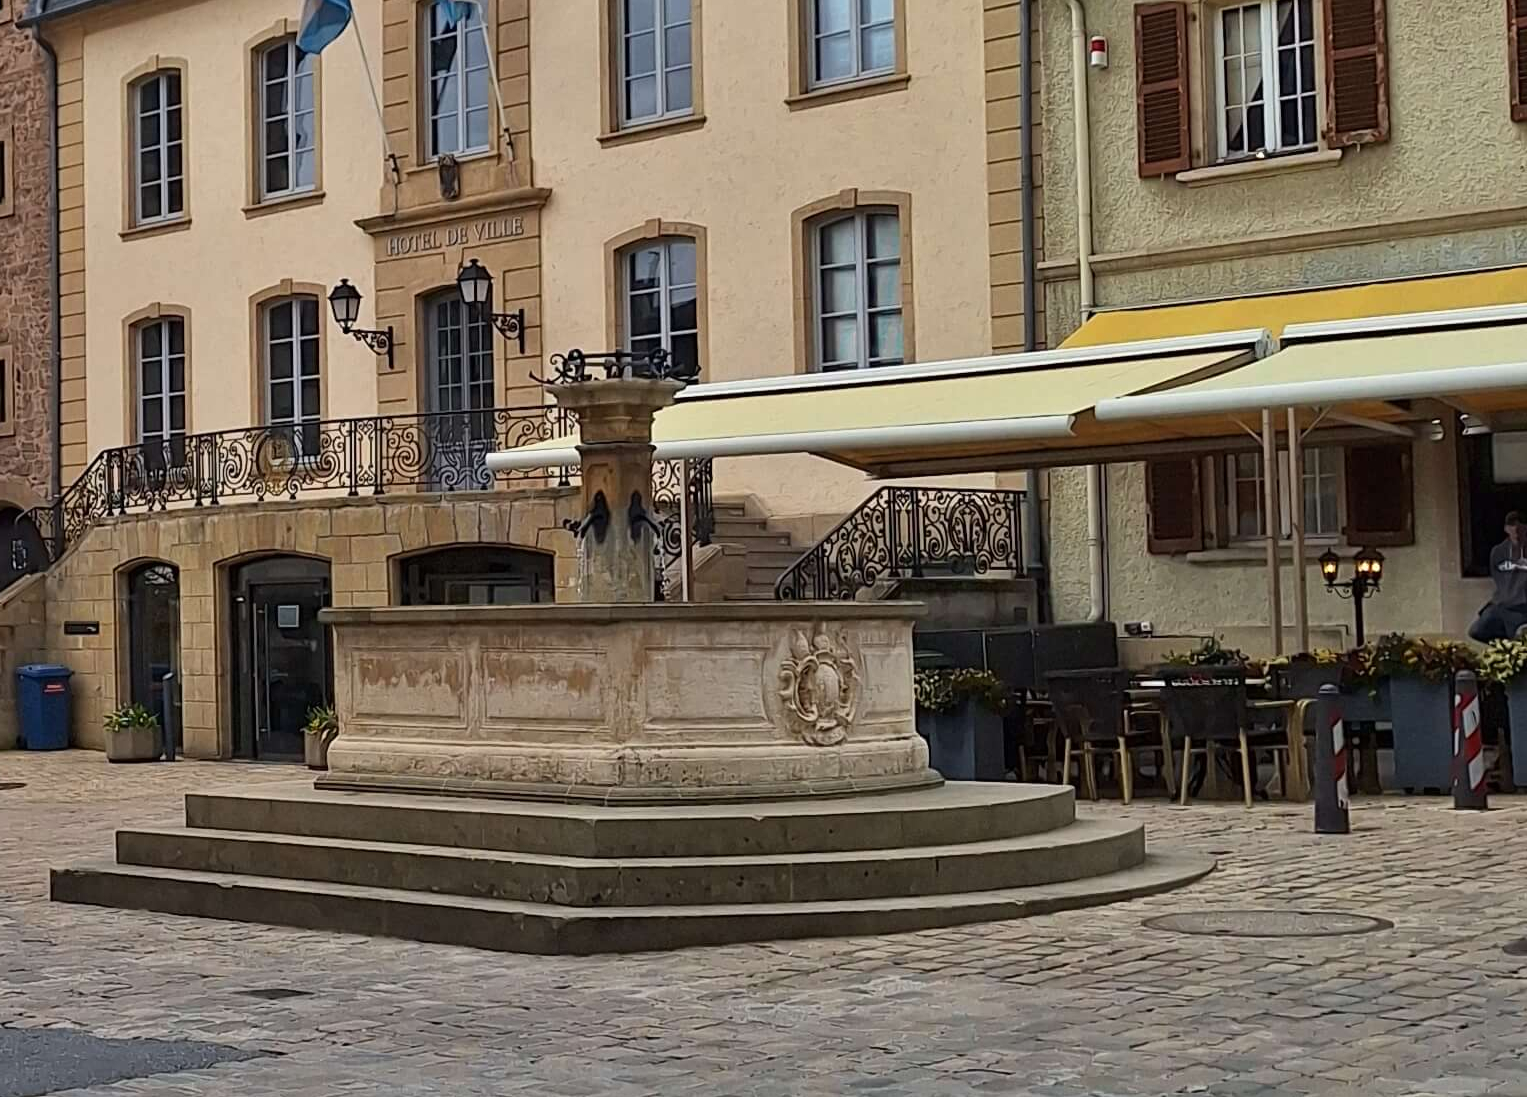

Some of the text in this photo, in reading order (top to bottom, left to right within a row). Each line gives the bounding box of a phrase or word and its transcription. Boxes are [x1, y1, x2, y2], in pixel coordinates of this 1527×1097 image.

[387, 216, 524, 256] HOTEL DE VILLE
